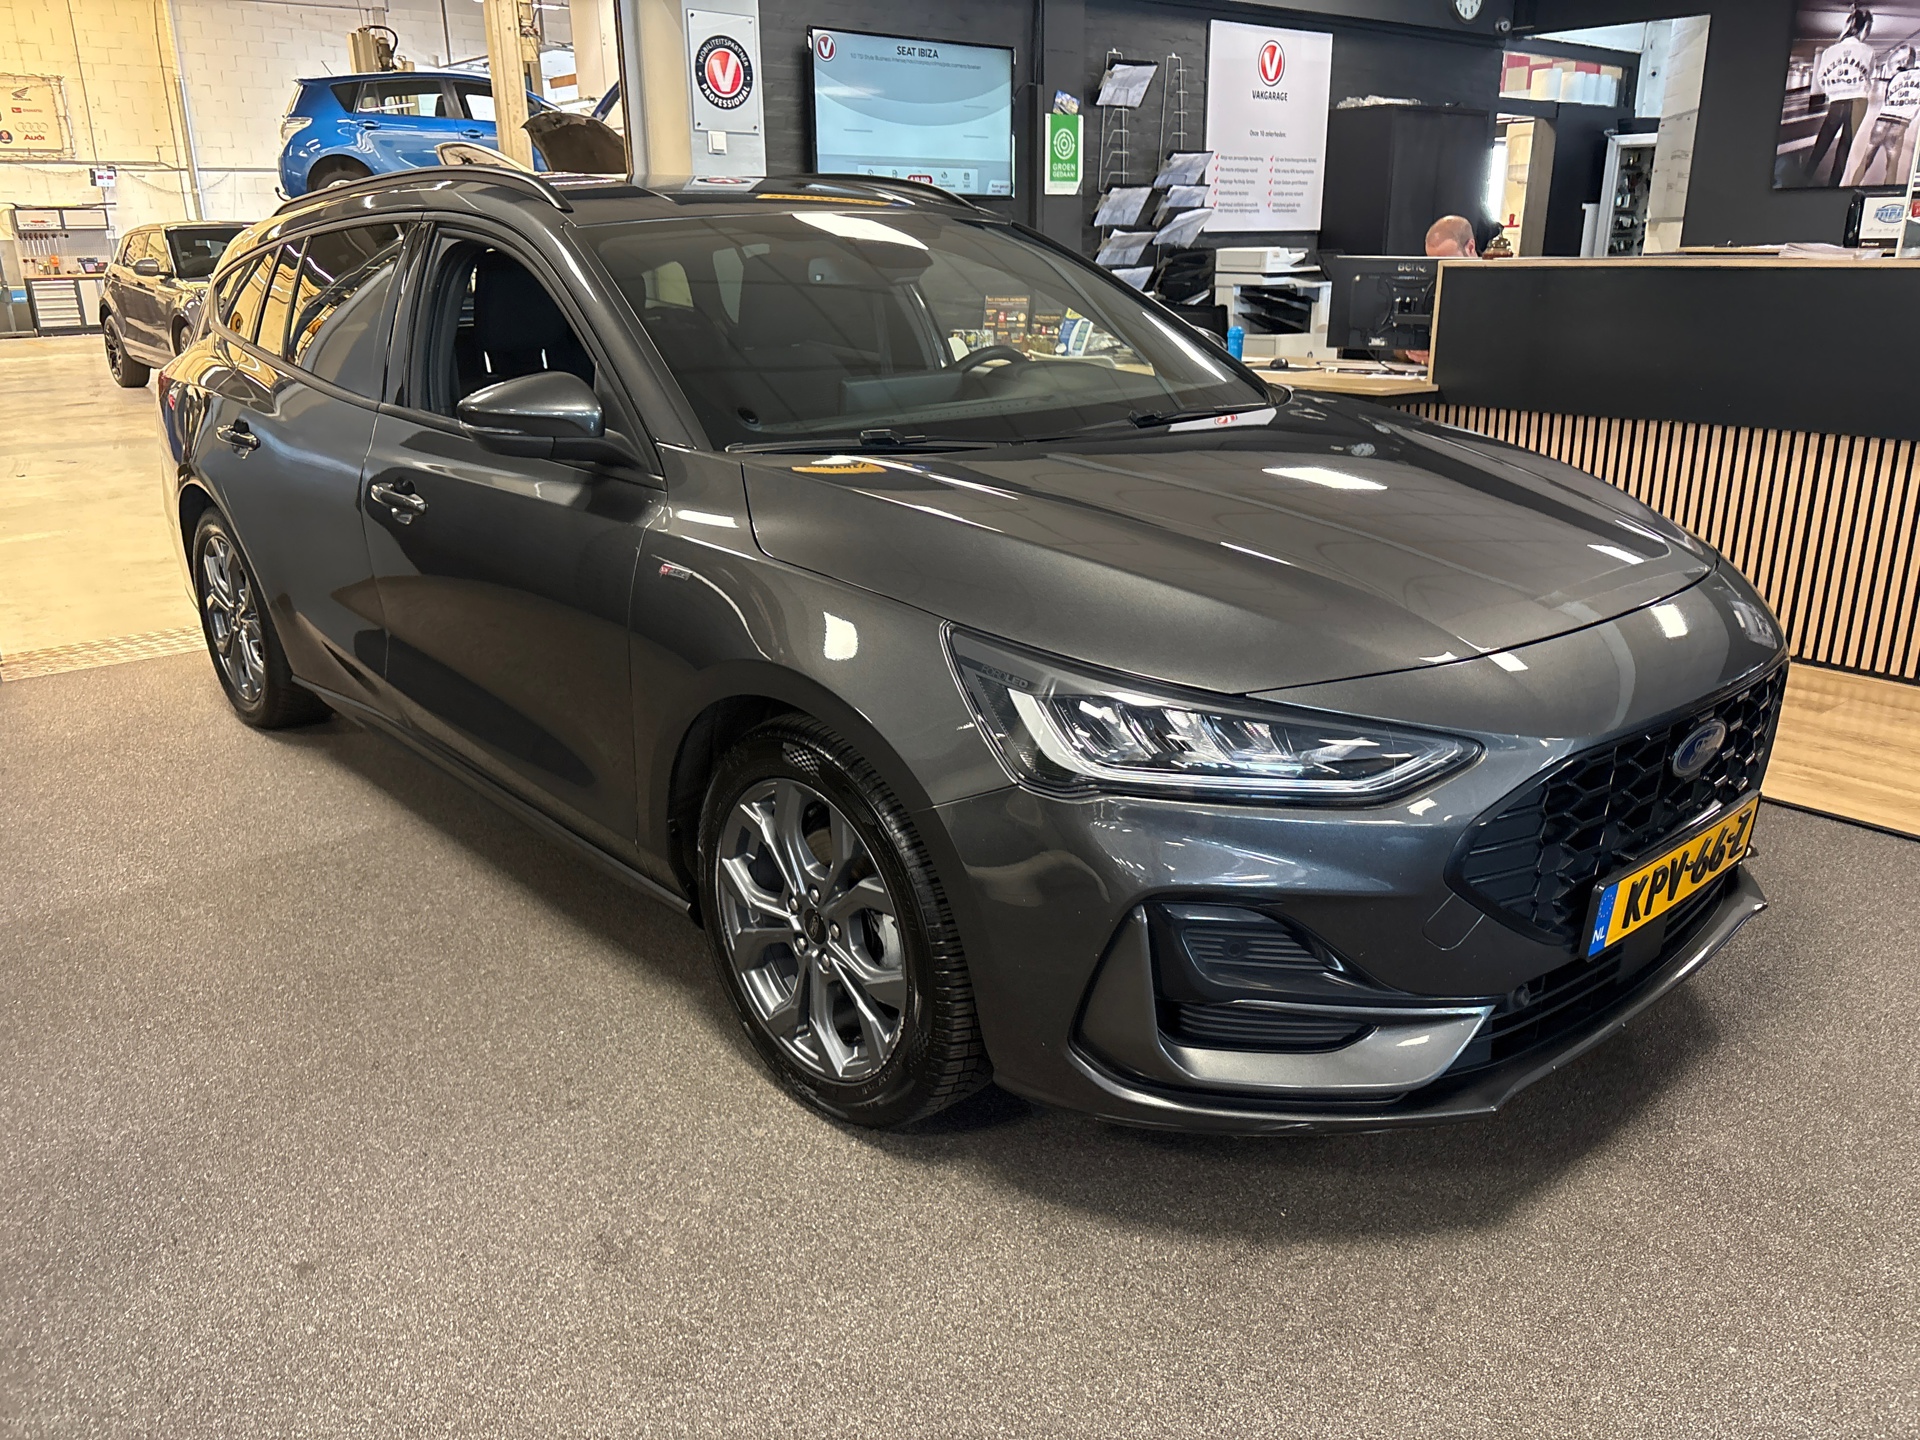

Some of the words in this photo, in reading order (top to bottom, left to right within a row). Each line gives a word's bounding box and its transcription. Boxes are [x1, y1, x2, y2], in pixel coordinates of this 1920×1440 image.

[698, 38, 749, 67] MOBILITEITSPARTNER
[896, 45, 915, 57] SEAT
[918, 47, 939, 59] IBIZA
[700, 83, 750, 108] PROFESSIONAL
[1252, 90, 1288, 101] VAKGARAGE
[1052, 163, 1075, 171] GROEN
[1621, 808, 1753, 929] KPV-66-Z
[1592, 926, 1605, 944] NL
